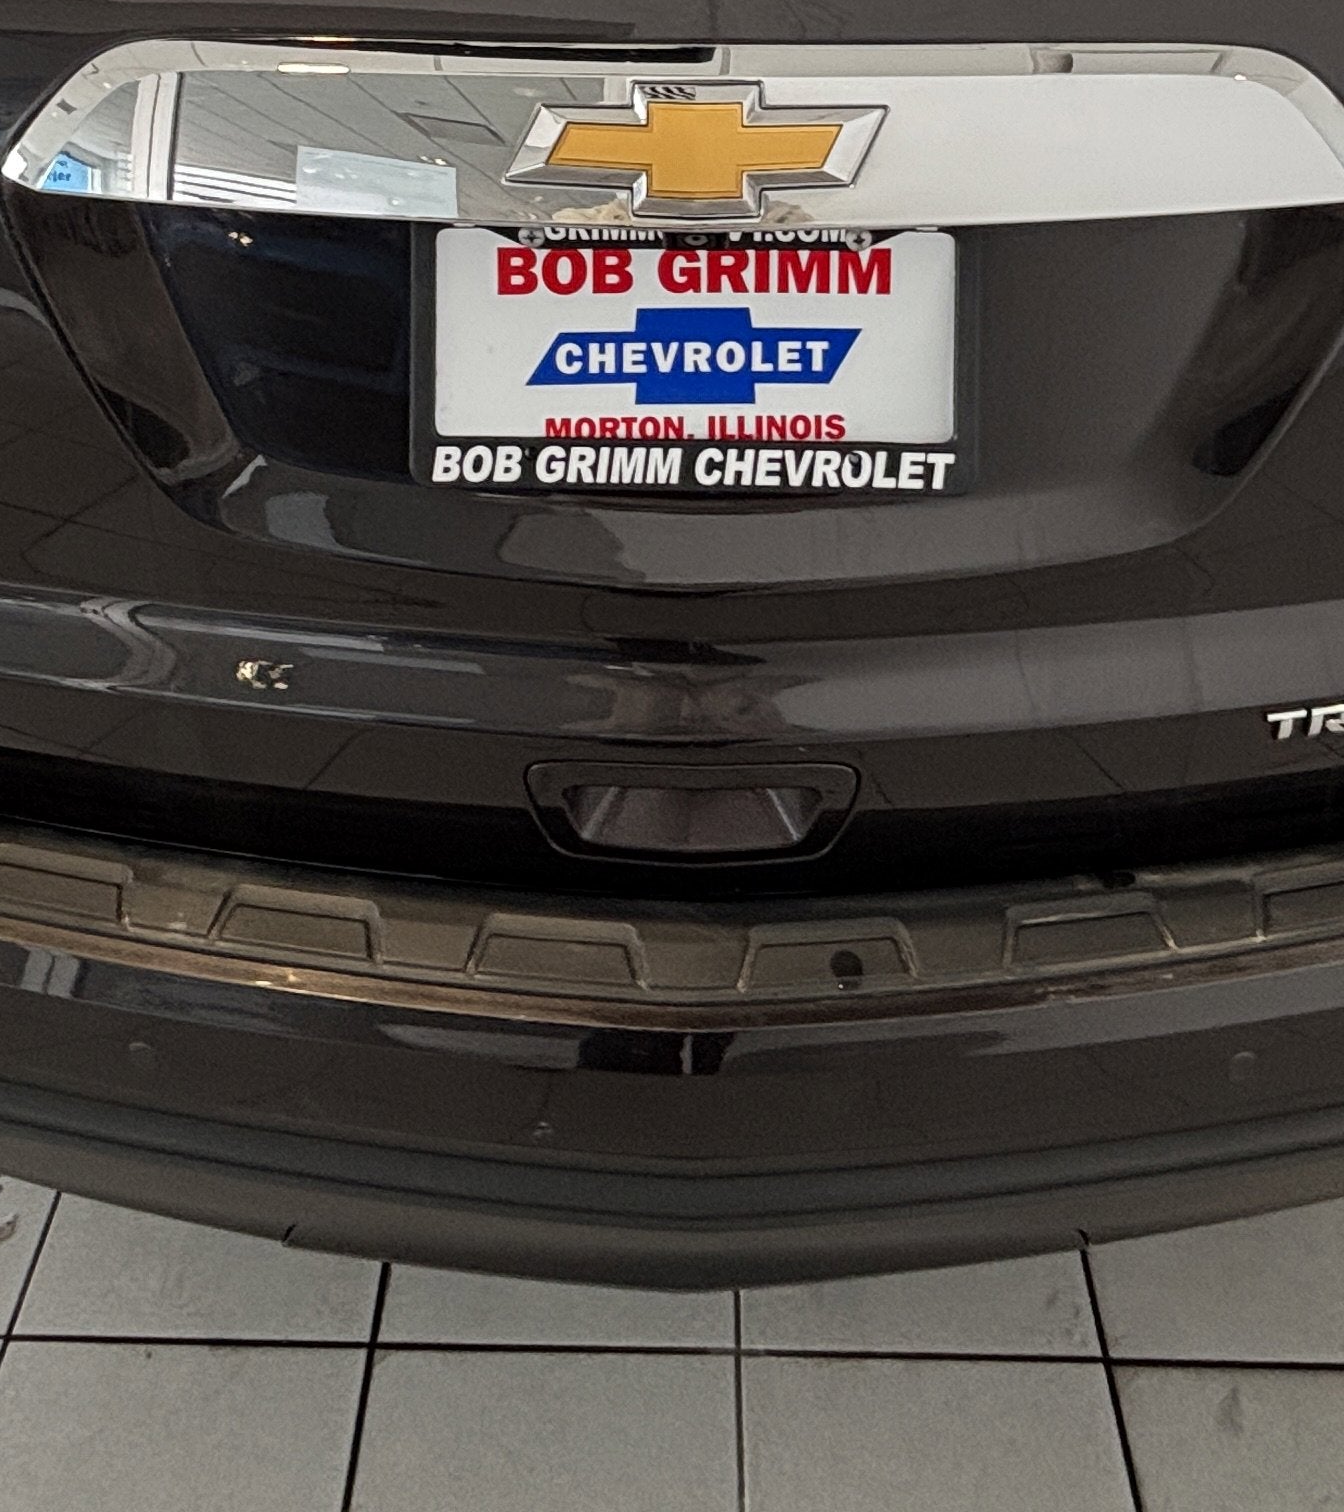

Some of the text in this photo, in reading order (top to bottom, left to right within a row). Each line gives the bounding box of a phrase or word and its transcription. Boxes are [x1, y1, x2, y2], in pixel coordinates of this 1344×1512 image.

[497, 247, 892, 295] BOB GRIMM
[555, 340, 830, 375] CHEVROLET
[708, 414, 846, 439] ILLINOIS
[432, 445, 956, 490] BOB GRIMM CHEVROLET
